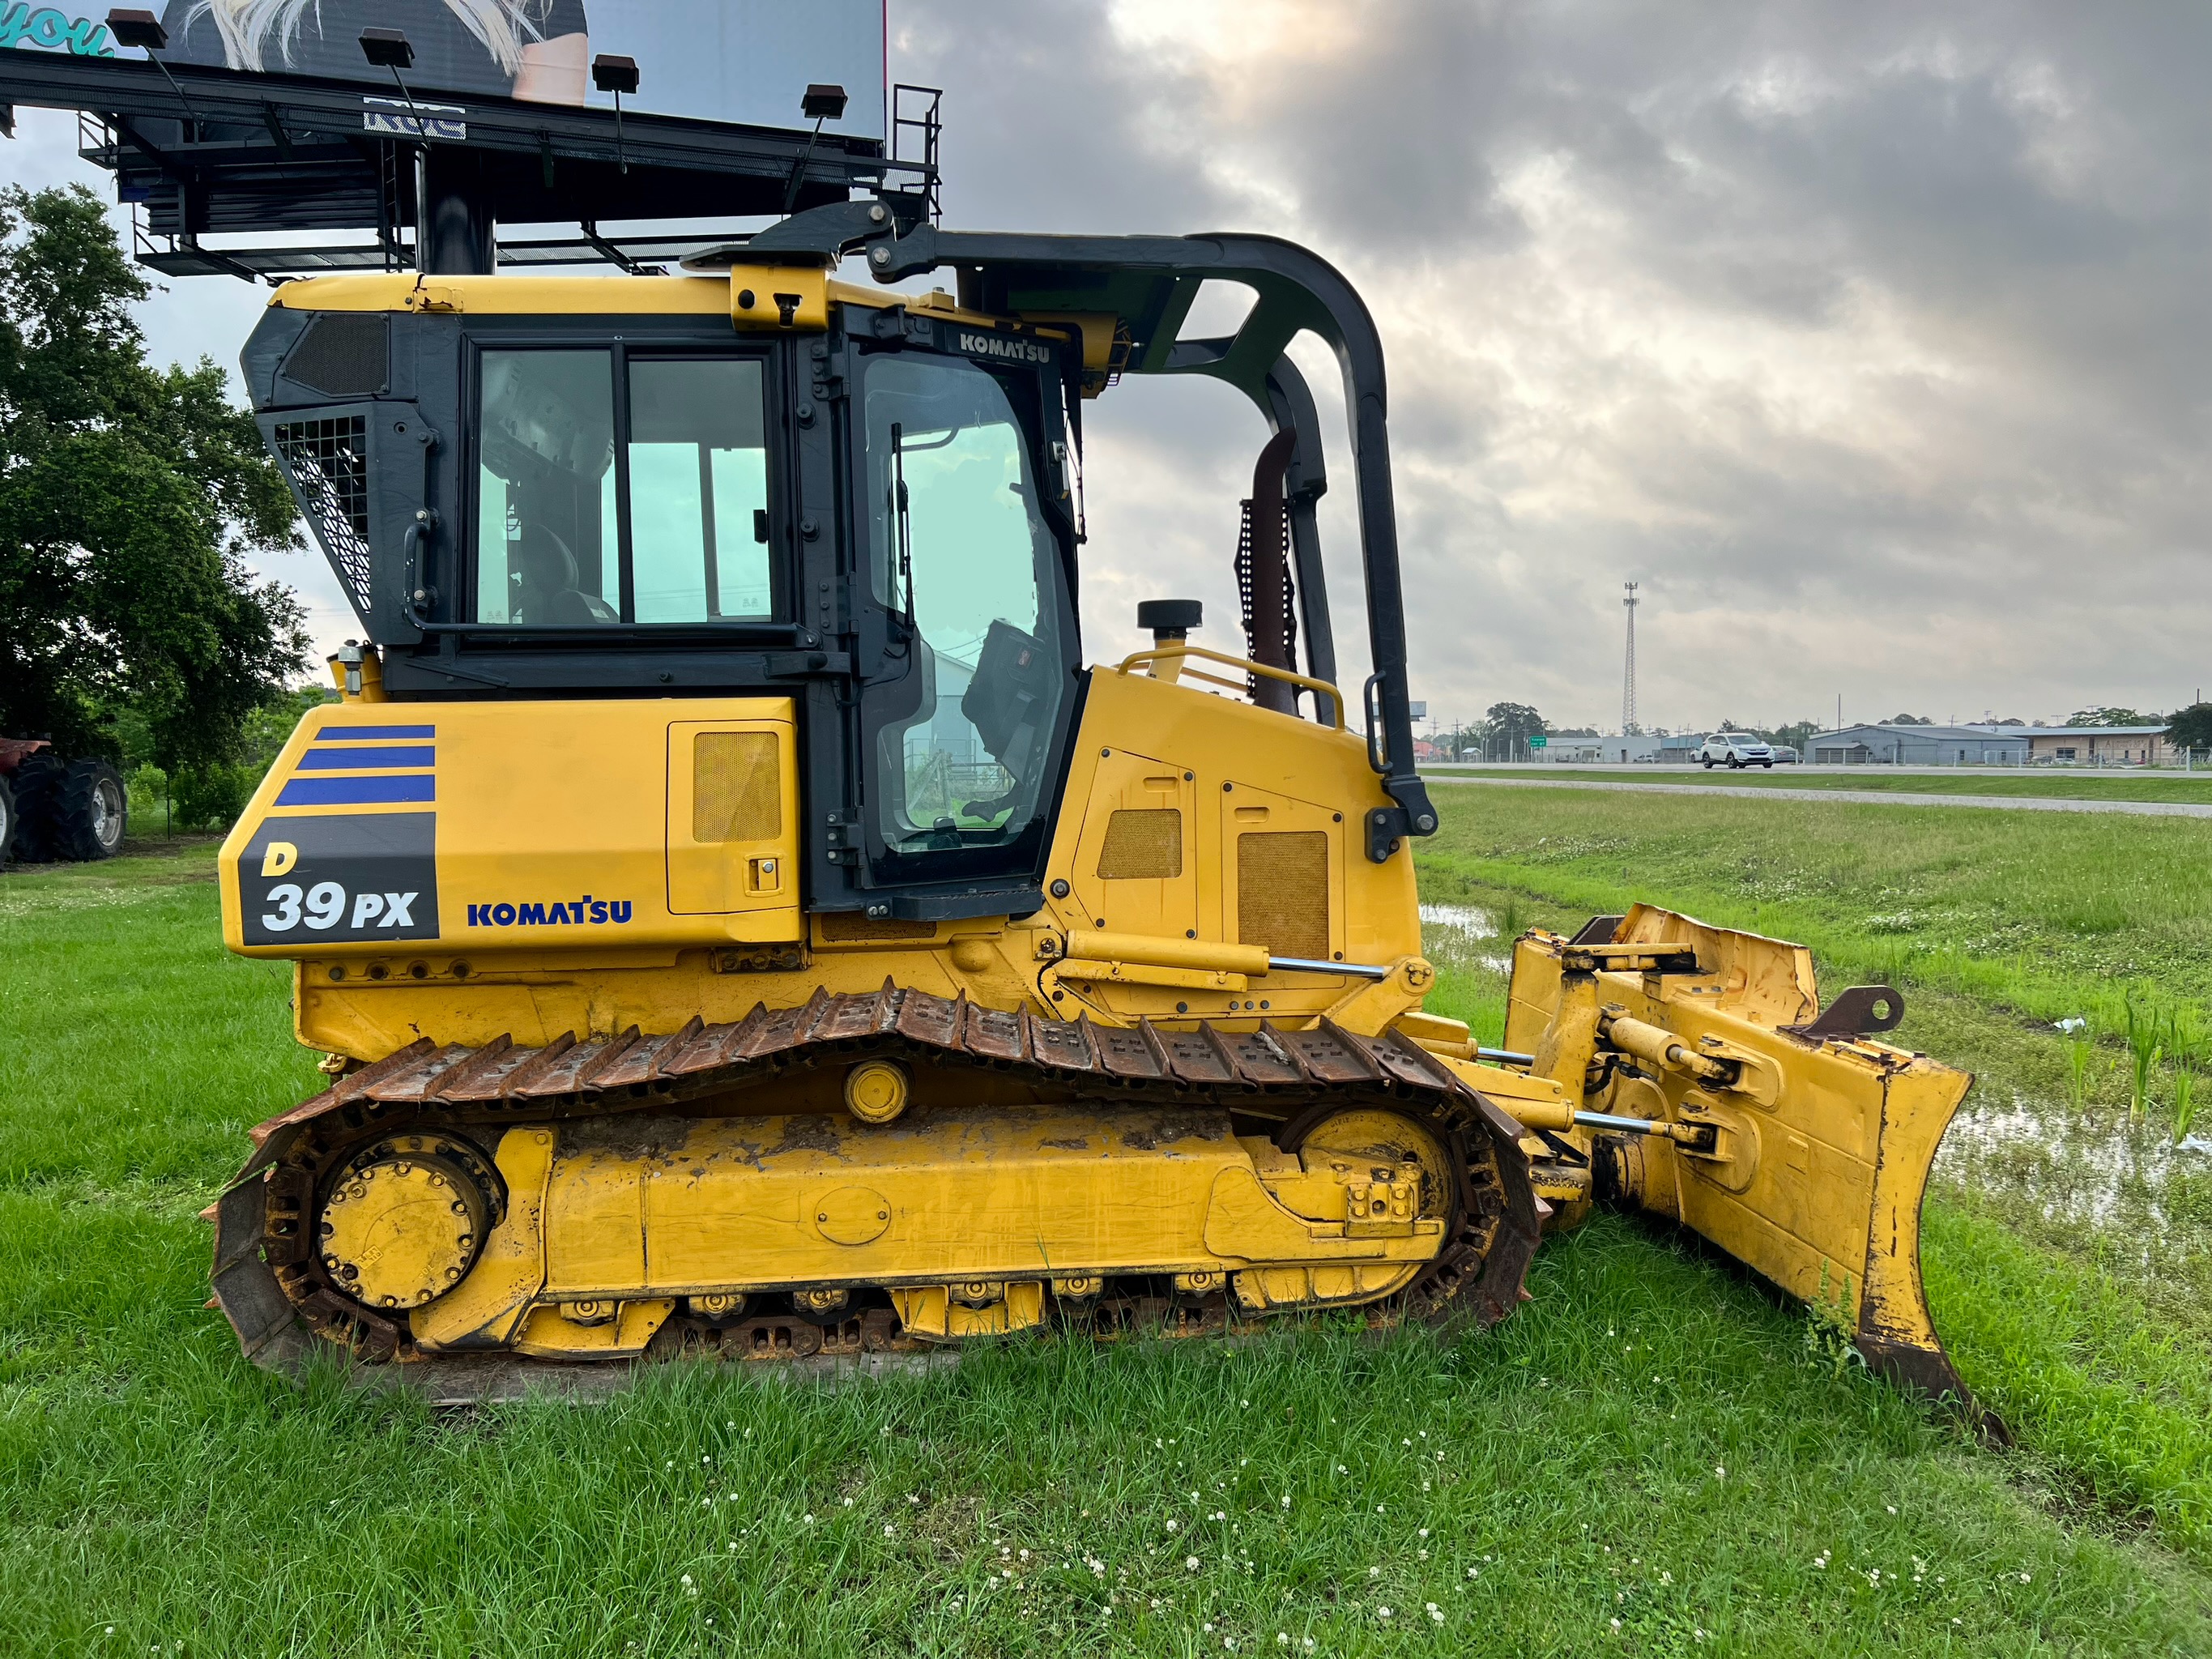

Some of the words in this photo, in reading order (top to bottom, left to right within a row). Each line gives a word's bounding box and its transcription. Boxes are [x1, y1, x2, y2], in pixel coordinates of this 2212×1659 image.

[0, 0, 114, 58] you
[960, 333, 1051, 364] KOMATSU
[261, 842, 298, 877] D
[261, 881, 346, 932] 39
[351, 892, 419, 928] PX
[467, 895, 633, 927] KOMATSU
